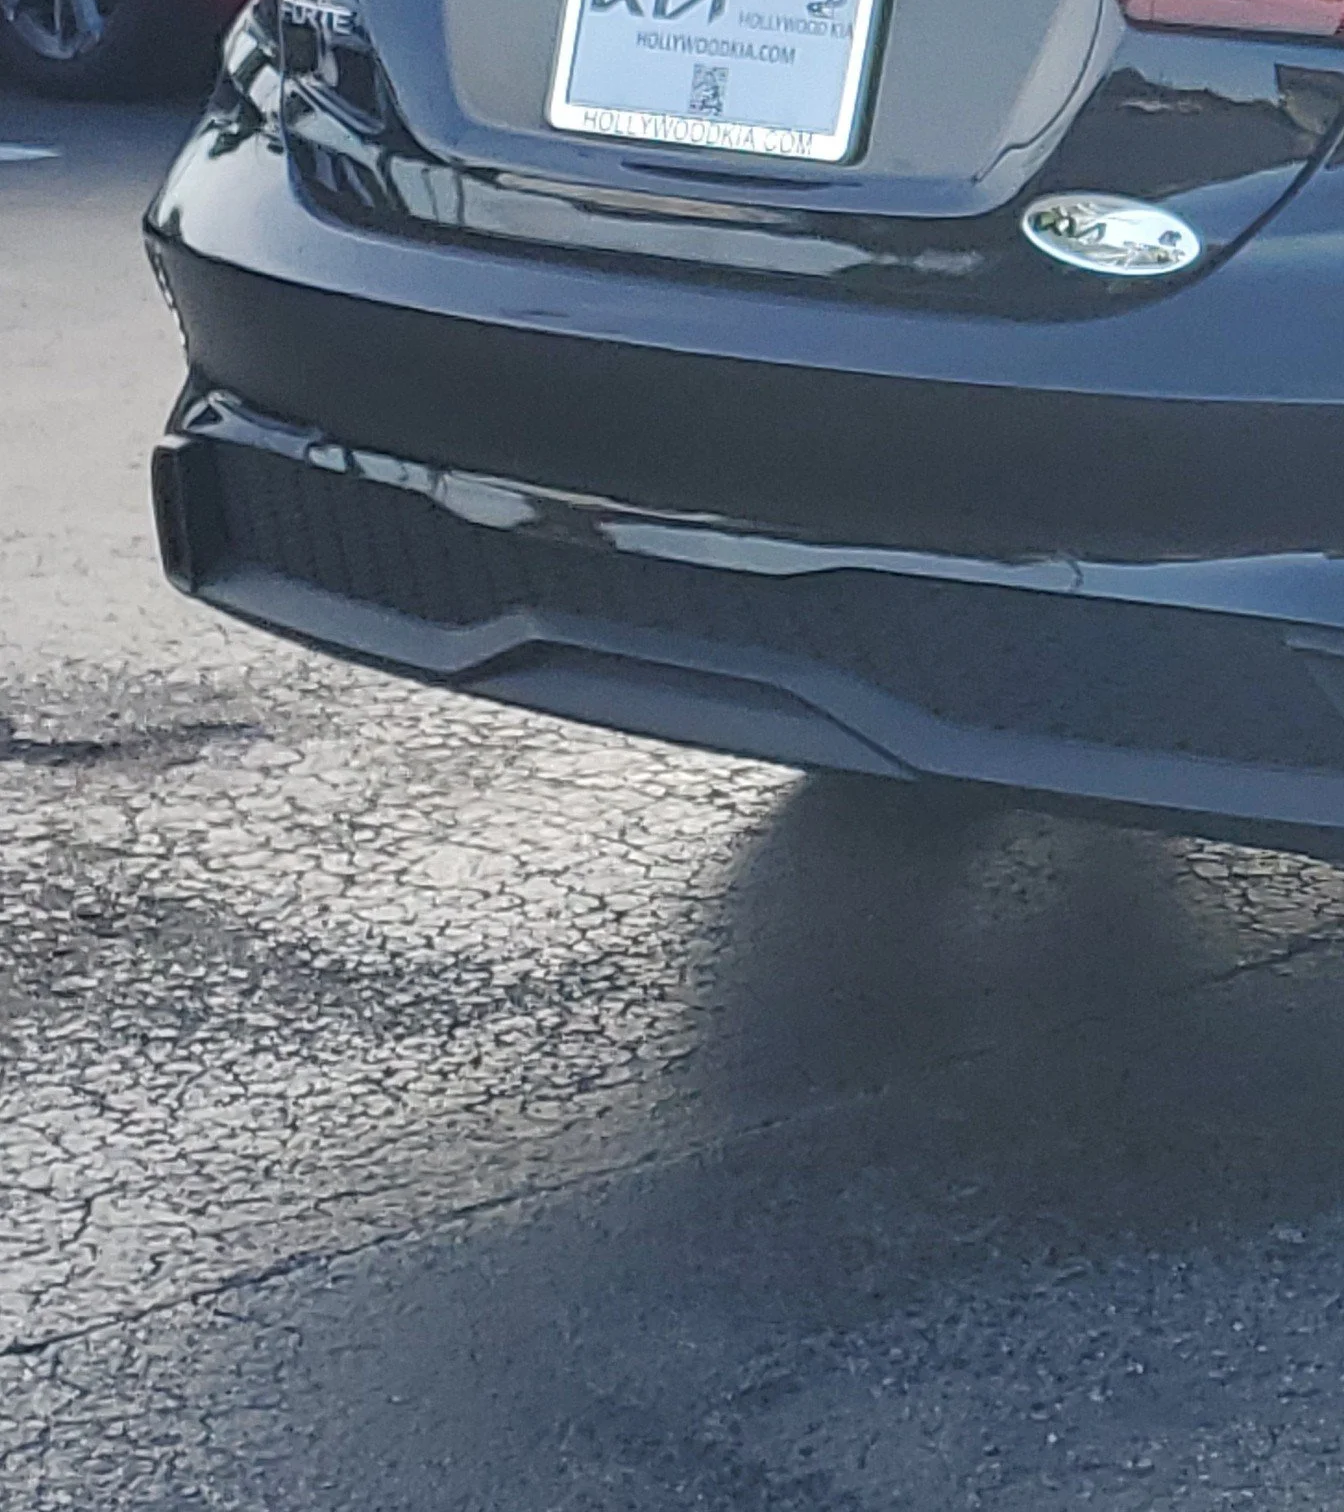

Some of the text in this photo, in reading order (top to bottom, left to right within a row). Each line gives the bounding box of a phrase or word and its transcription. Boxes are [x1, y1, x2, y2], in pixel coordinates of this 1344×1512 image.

[739, 9, 854, 39] HOLLYWOOD KIA
[635, 31, 797, 66] HOLLYWOODKIA.COM
[583, 109, 814, 155] HOLLYWOODKIACOM
